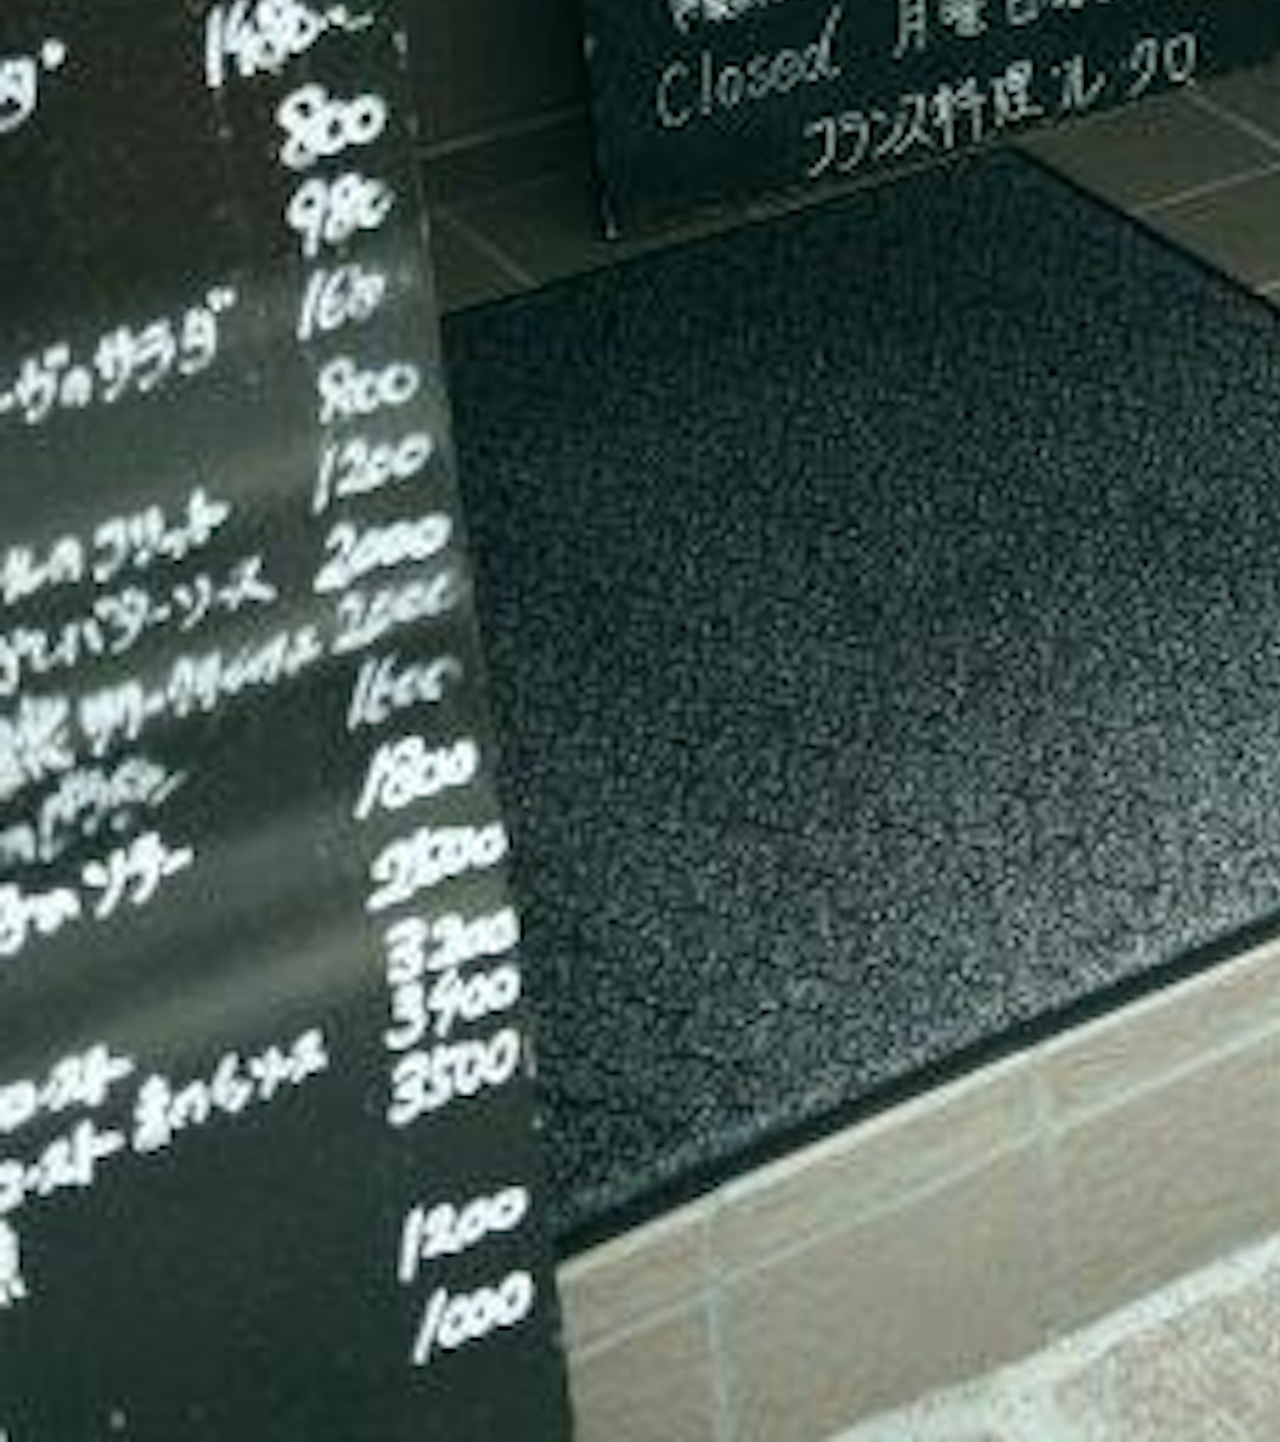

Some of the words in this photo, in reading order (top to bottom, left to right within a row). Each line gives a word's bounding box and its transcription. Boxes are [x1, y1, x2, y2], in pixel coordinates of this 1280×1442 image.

[655, 3, 842, 128] Closed
[312, 433, 434, 516] 1200
[352, 736, 480, 820] 1800
[384, 1028, 522, 1126] 3500
[397, 1185, 531, 1284] 1200
[413, 1269, 535, 1365] 1000
